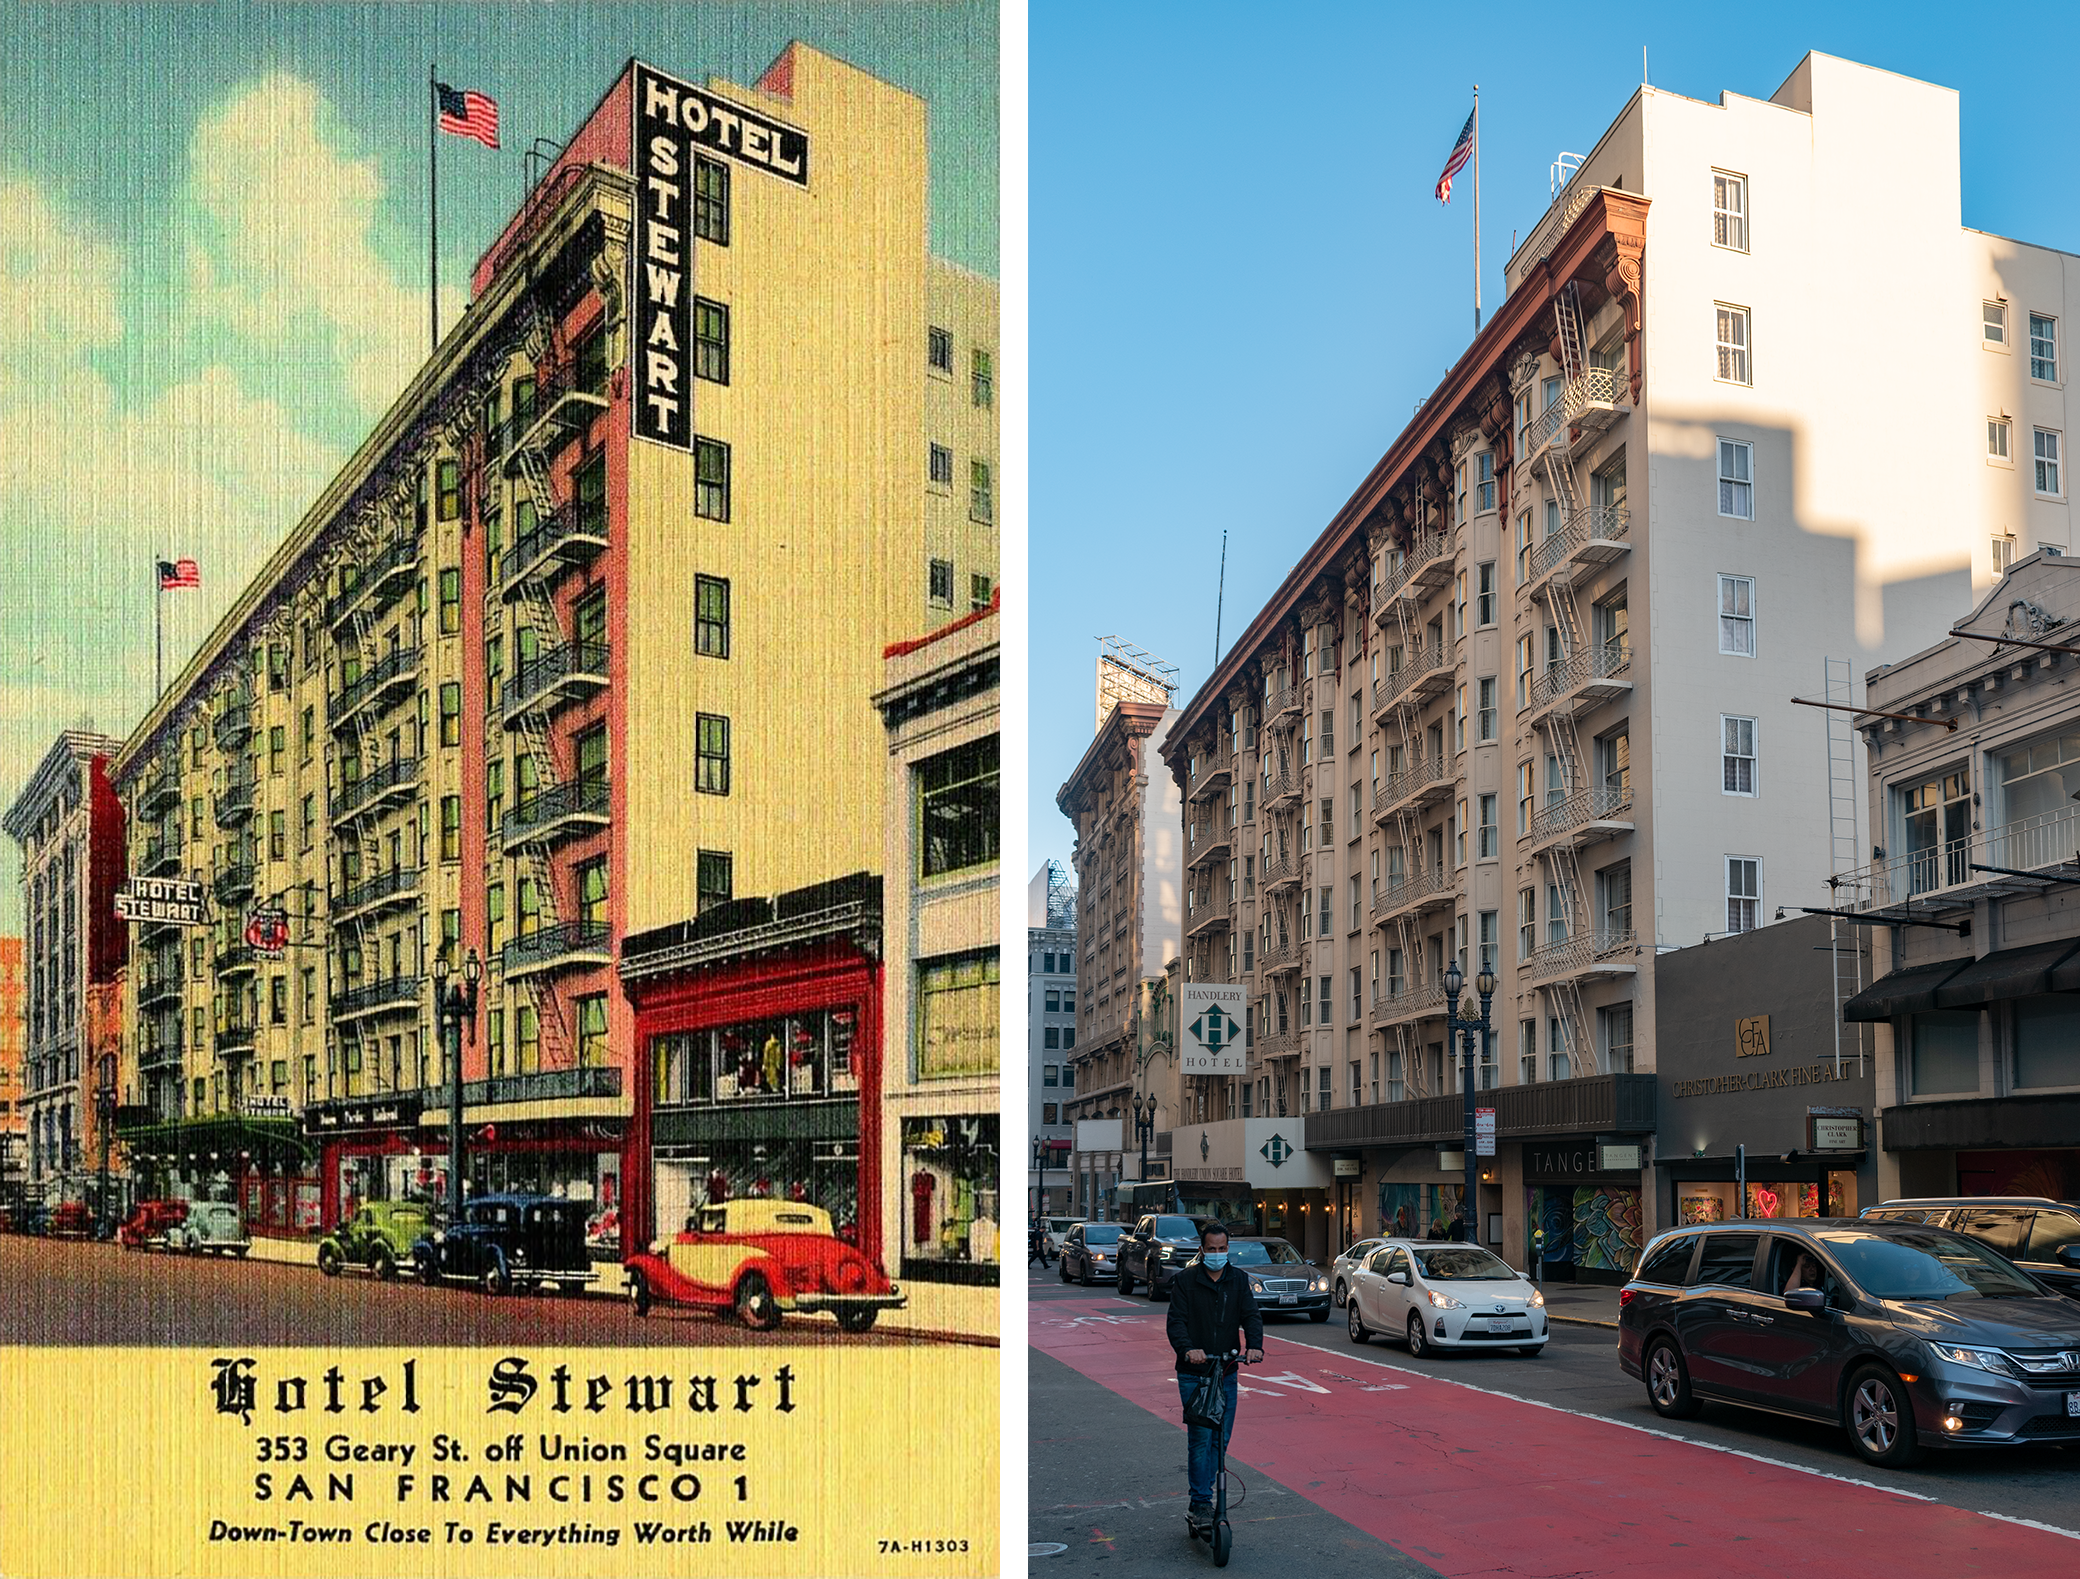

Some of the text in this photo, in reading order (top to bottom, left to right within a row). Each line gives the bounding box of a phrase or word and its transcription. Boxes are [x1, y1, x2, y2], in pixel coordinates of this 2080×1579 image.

[645, 76, 801, 177] HOTEL
[647, 135, 682, 435] STEWART
[136, 880, 200, 902] HOTEL
[117, 900, 200, 921] STEWART
[1187, 990, 1242, 1001] HANDLERY
[1186, 1057, 1243, 1068] HOTEL
[1791, 1064, 1821, 1087] FINE
[1533, 1151, 1595, 1173] TANGE
[210, 1357, 796, 1426] Hotel Stewart
[256, 1434, 746, 1467] 353 Geary St. off Union Square
[254, 1472, 748, 1503] SAN FRANCISCO 1
[208, 1519, 799, 1547] Down-Town Close To Everything Worth While
[877, 1540, 969, 1553] 7A-H1303
